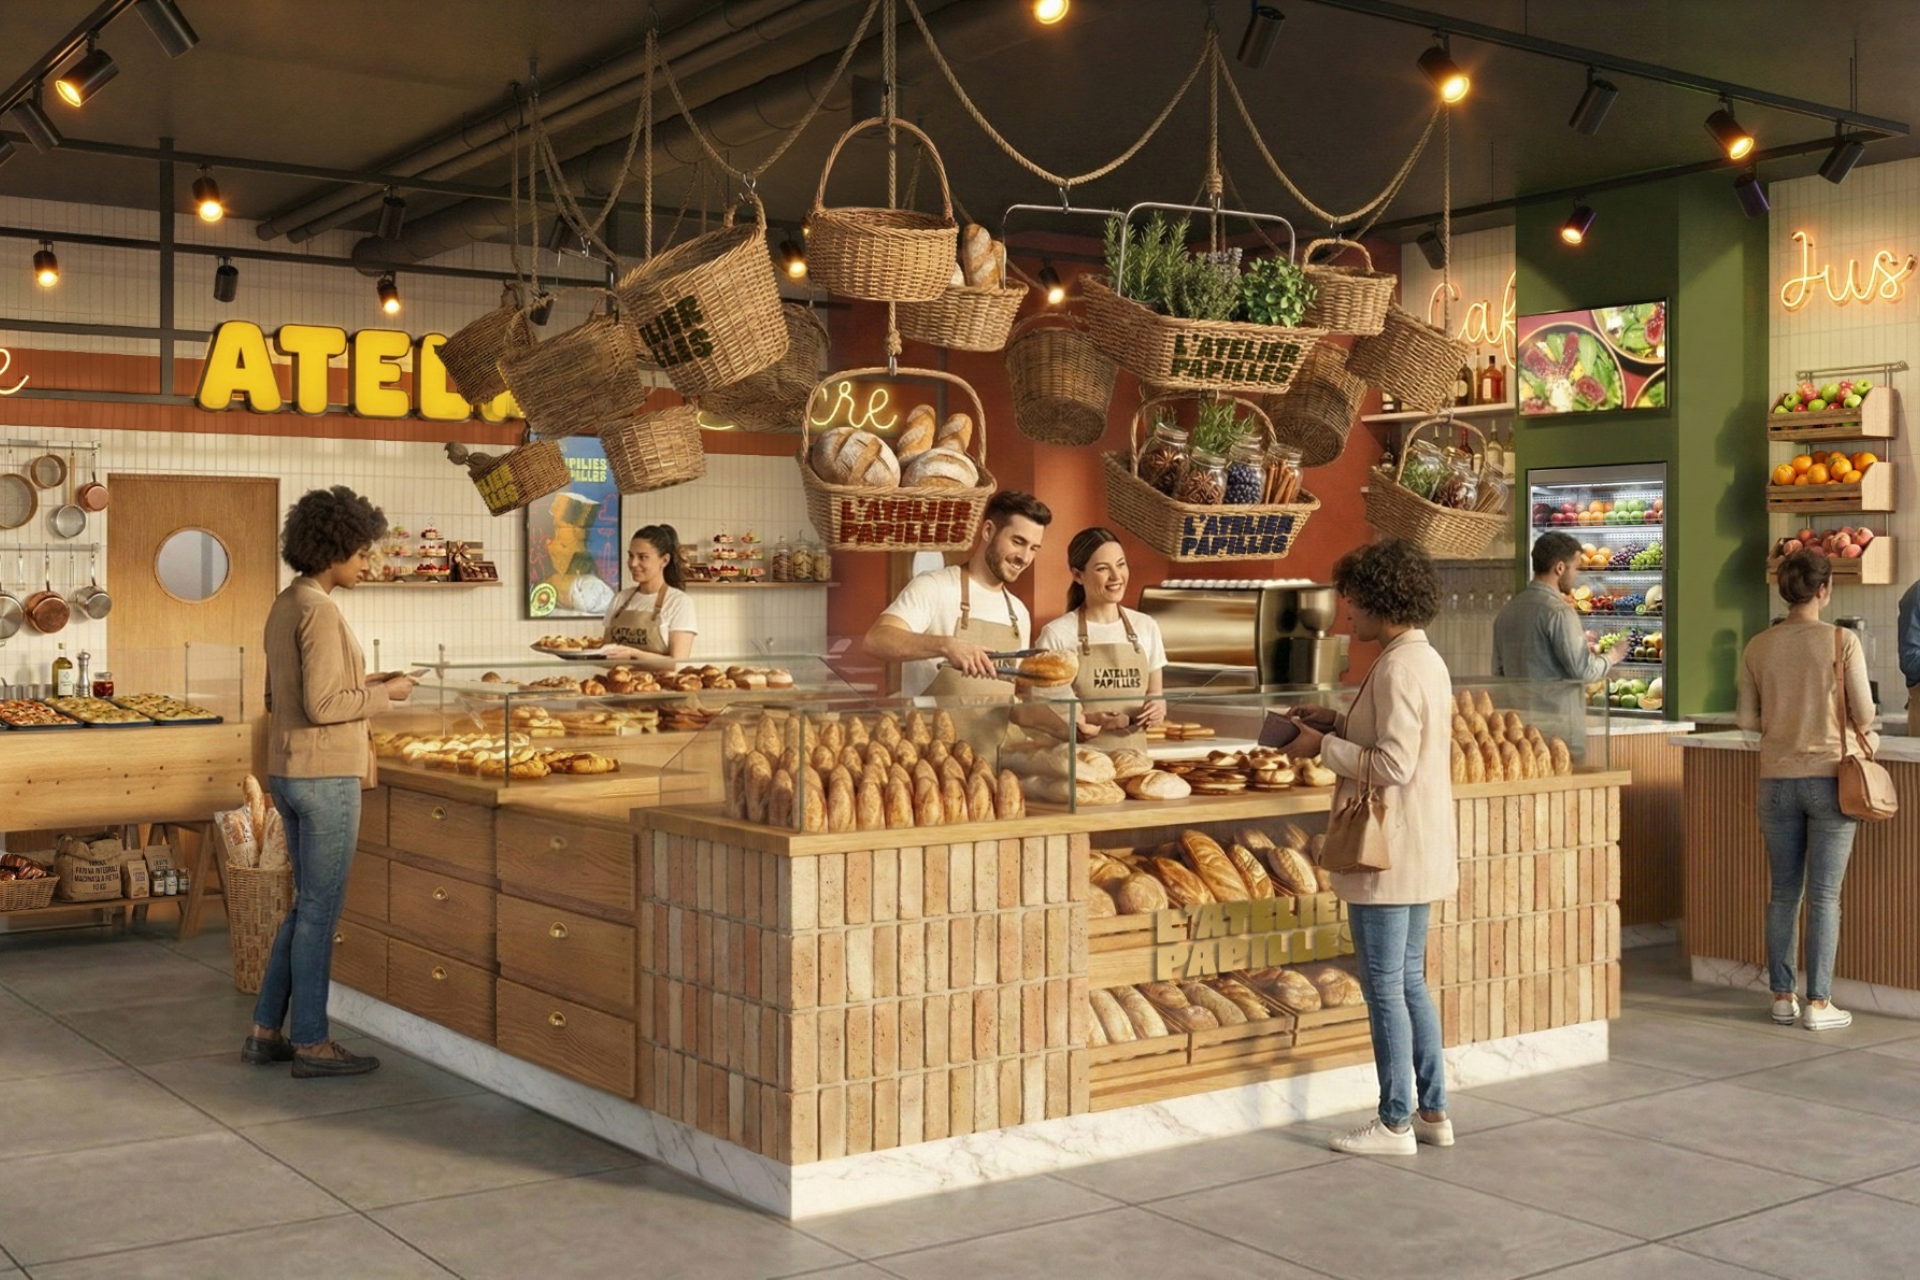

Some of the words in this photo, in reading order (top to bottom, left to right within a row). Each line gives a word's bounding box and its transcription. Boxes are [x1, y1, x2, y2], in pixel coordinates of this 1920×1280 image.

[1780, 231, 1914, 307] Jus
[1174, 333, 1300, 363] L'ATELIER
[1171, 357, 1293, 383] PAPILLES
[841, 498, 972, 522] L'ATELIER
[840, 522, 967, 543] PAPILLES
[1183, 514, 1295, 535] L'ATELIER
[1181, 535, 1288, 555] PAPILLES
